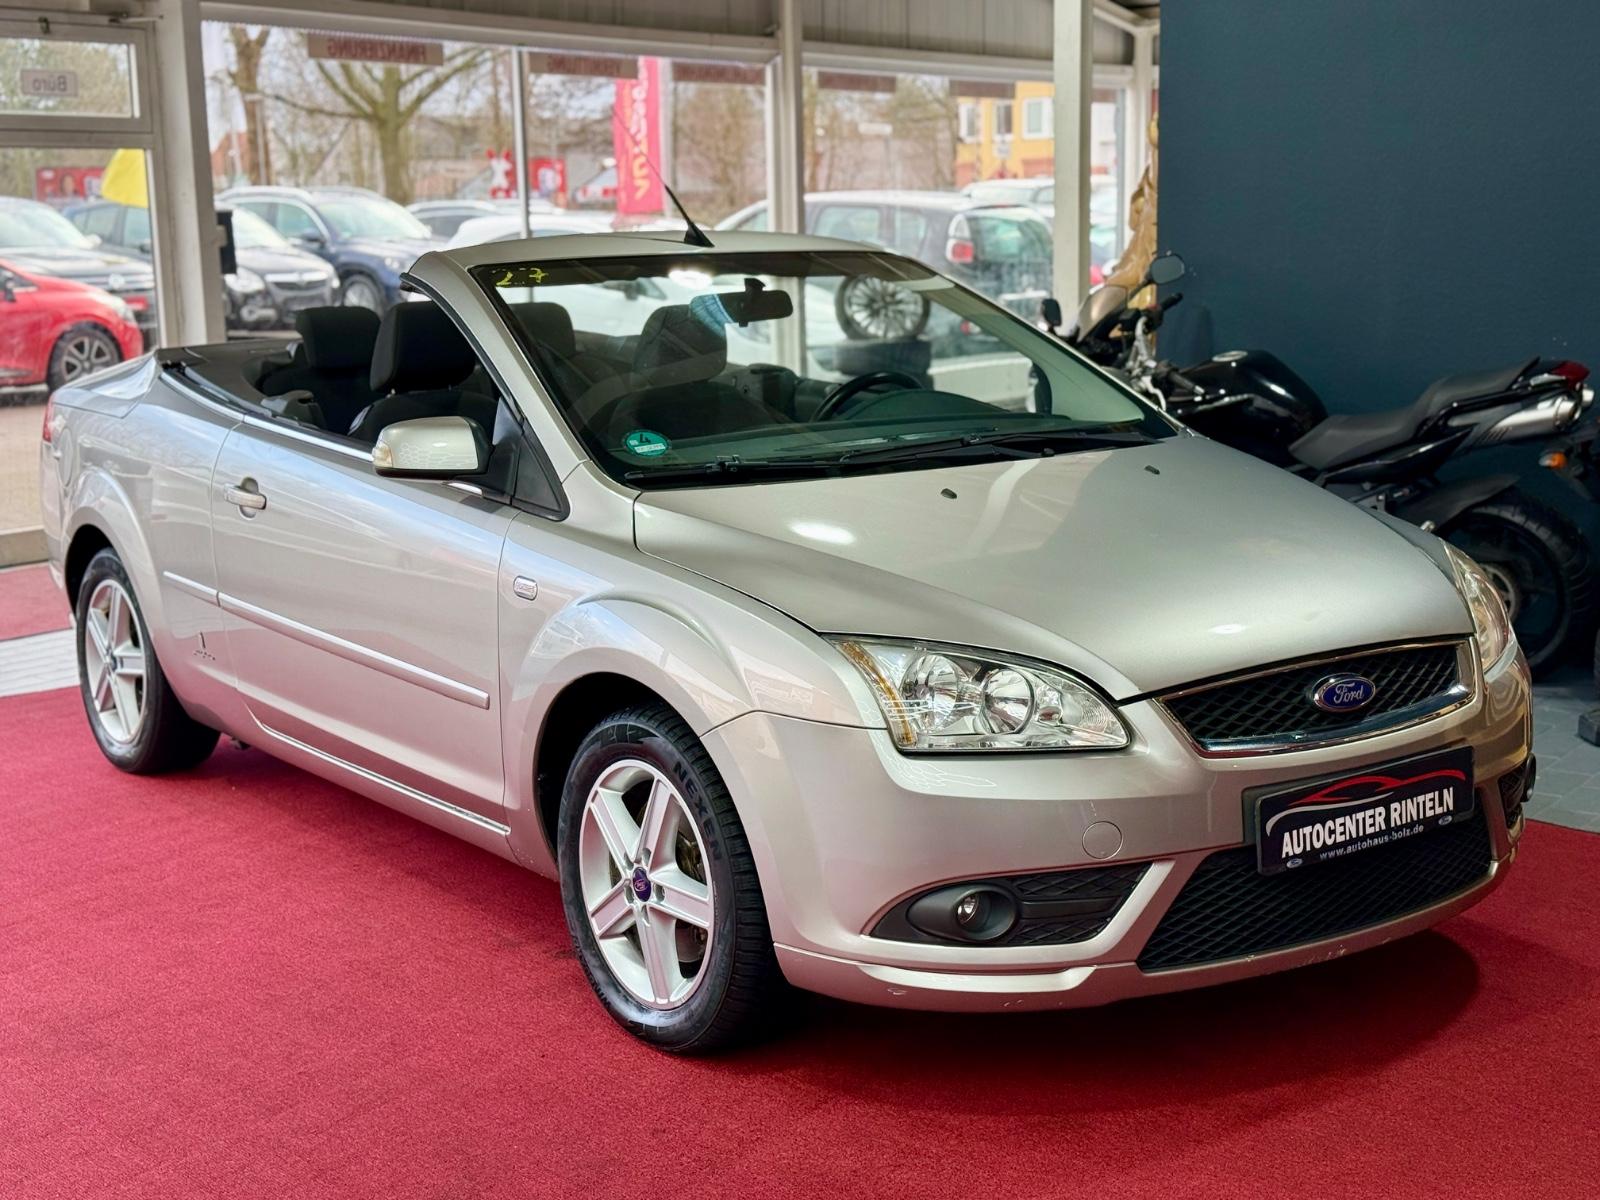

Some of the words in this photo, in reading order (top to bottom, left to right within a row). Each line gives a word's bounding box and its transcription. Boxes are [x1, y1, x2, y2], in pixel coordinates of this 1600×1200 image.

[640, 433, 652, 444] 4
[1333, 682, 1364, 704] Ford
[673, 761, 722, 860] NEXEN
[1282, 806, 1386, 859] AUTOCENTER
[1390, 787, 1454, 828] RINTELN
[1319, 823, 1424, 860] www.autohaus-bolz.de
